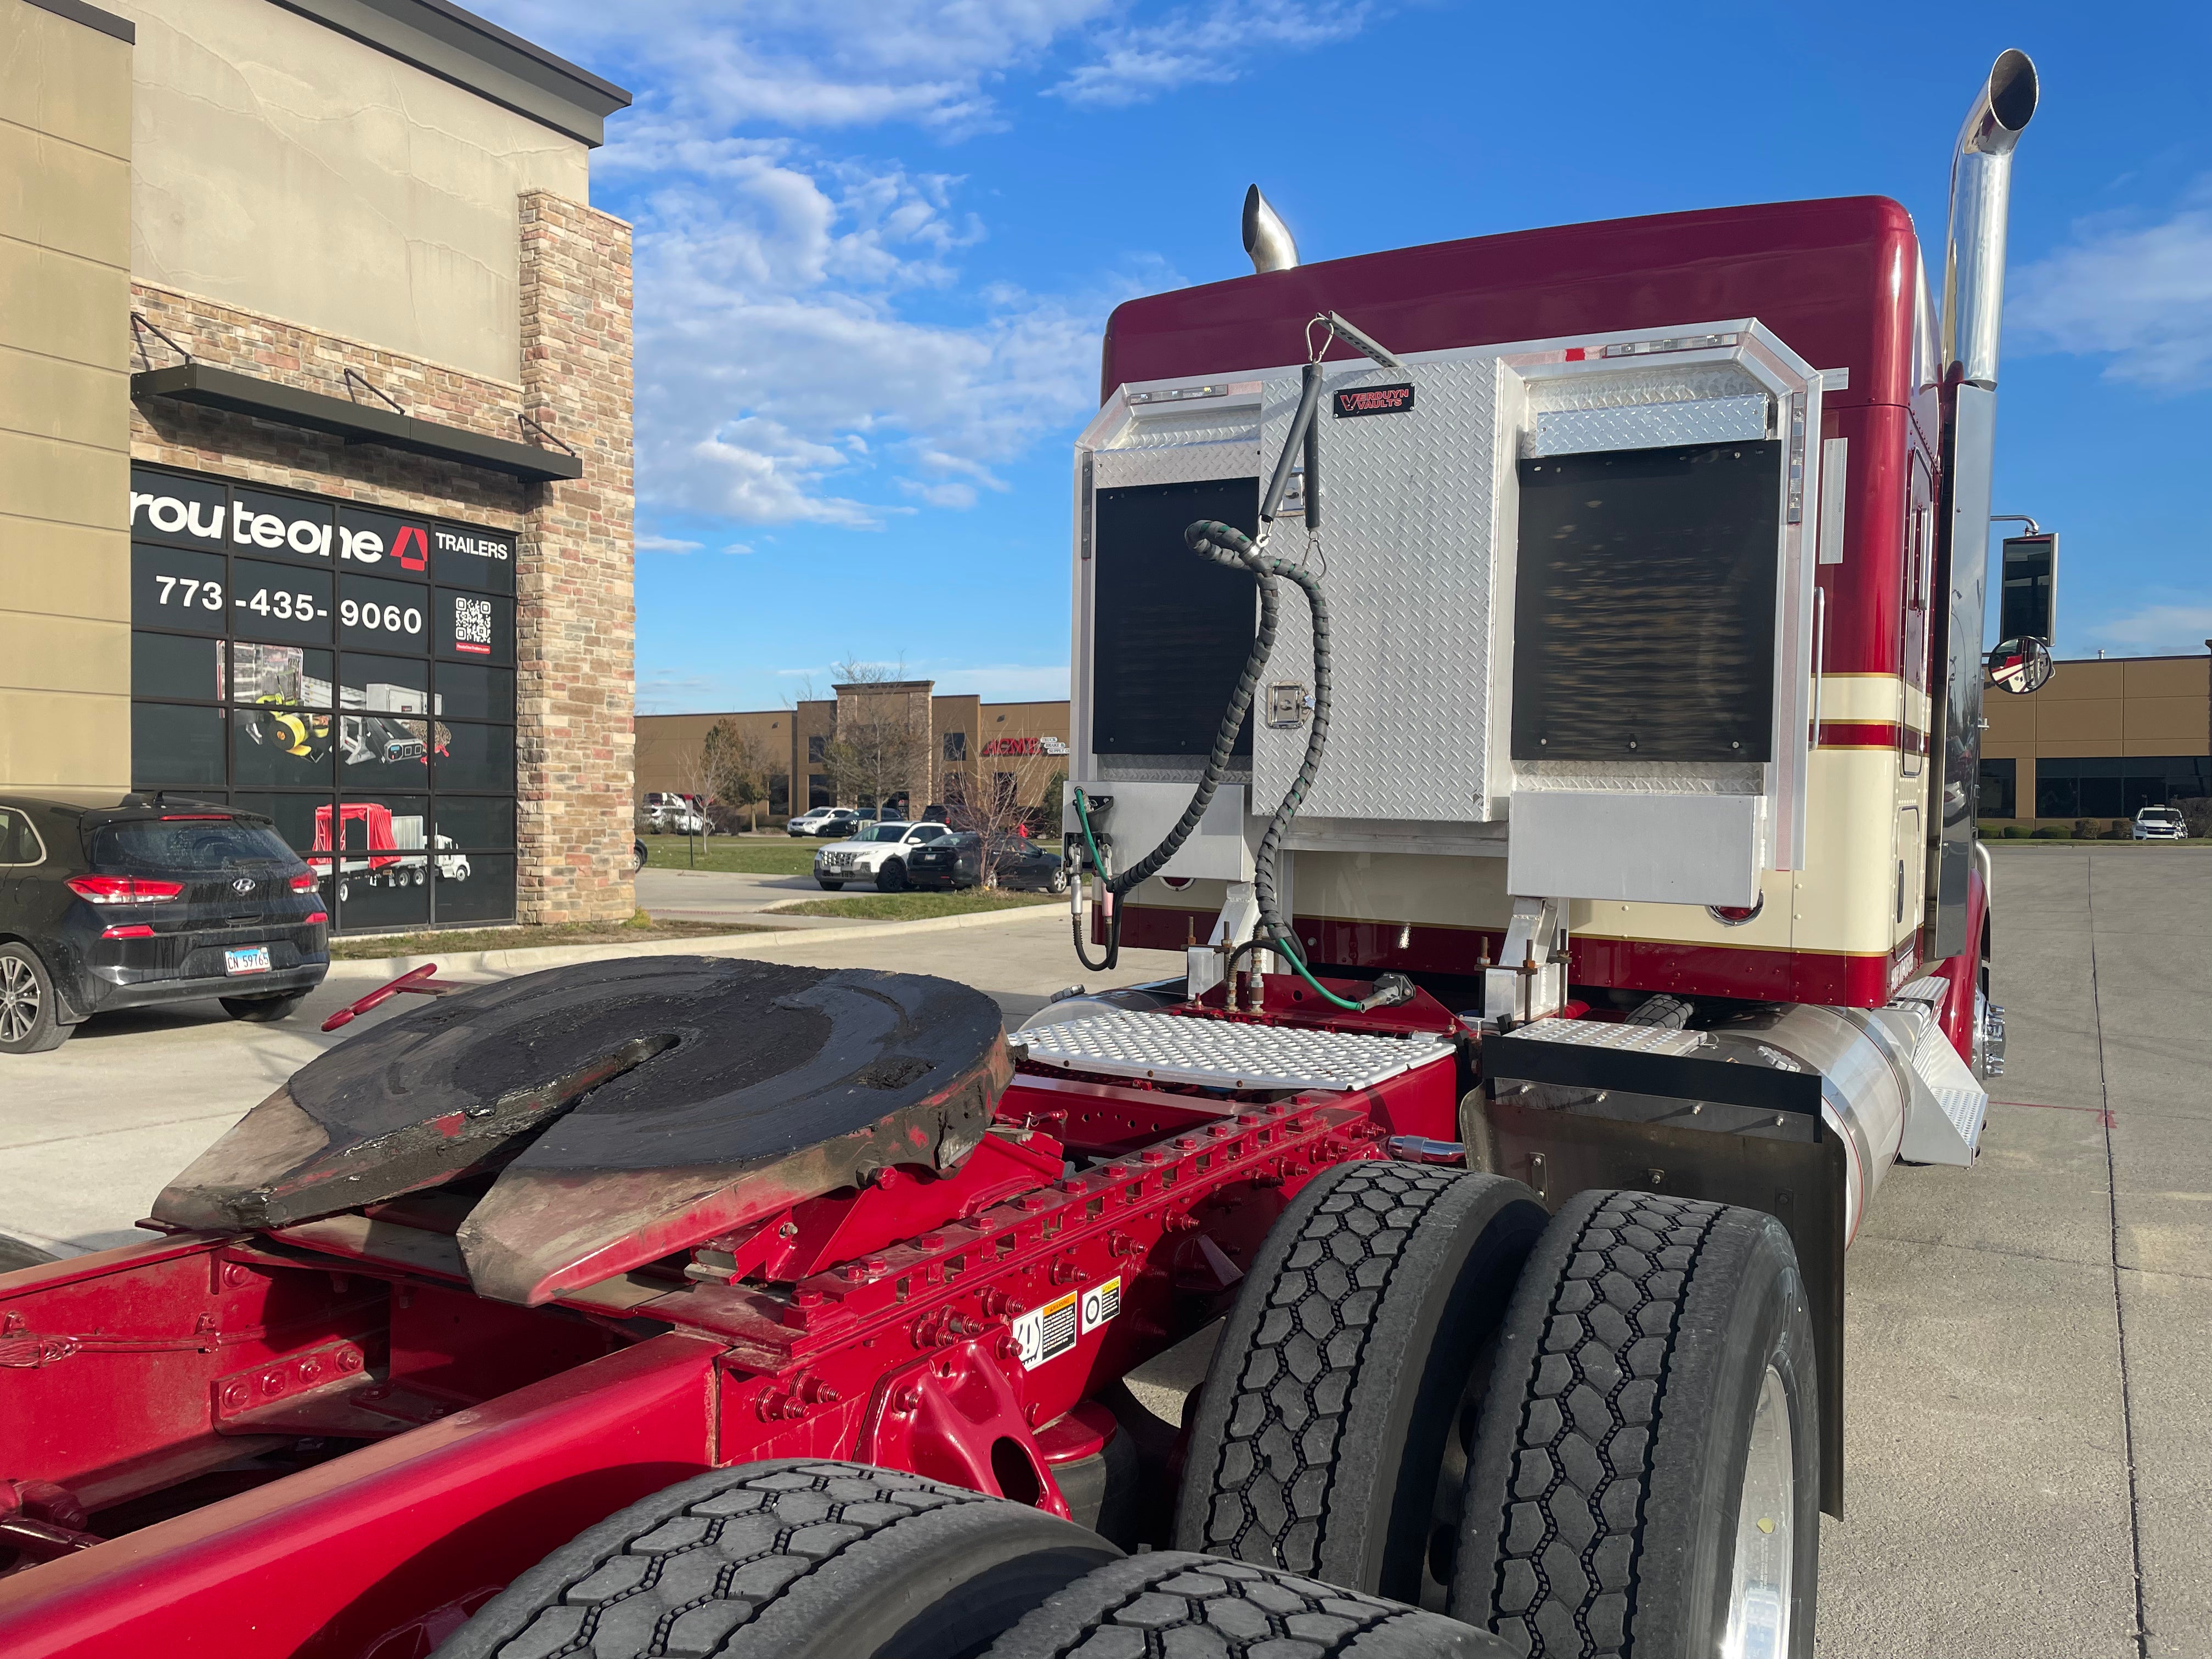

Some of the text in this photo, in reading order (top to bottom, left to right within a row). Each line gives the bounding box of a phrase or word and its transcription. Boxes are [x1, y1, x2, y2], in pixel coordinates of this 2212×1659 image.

[1340, 388, 1409, 411] VERDUYN
[1357, 399, 1402, 410] VAULTS
[130, 491, 508, 563] routeone TRAILERS
[983, 737, 1042, 754] ACME
[228, 953, 269, 970] CN 59765
[1104, 1280, 1119, 1291] CAUTION
[1052, 1299, 1070, 1310] WARNING
